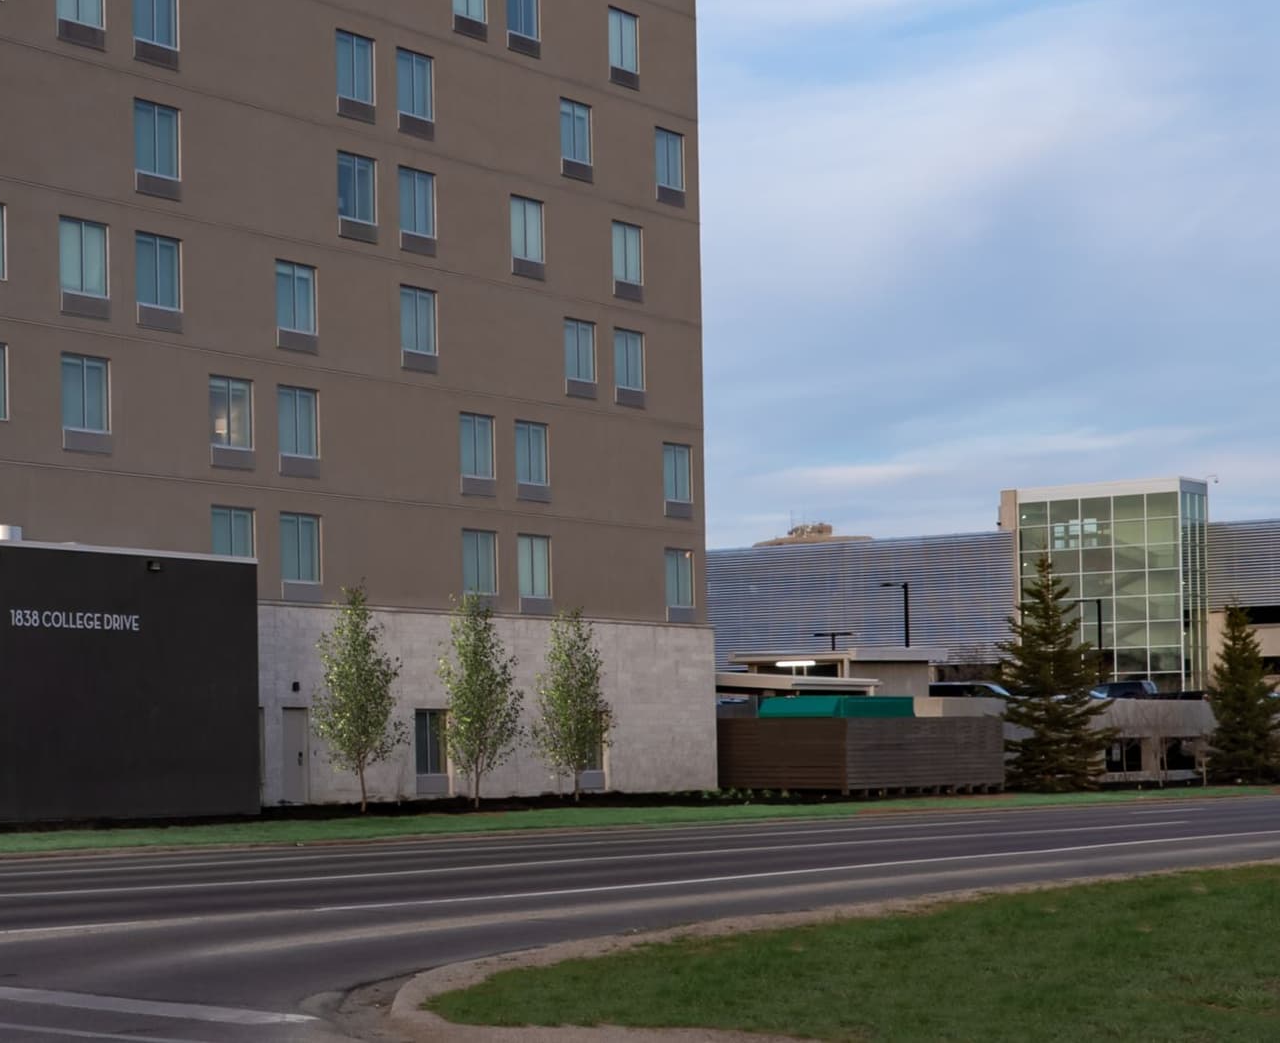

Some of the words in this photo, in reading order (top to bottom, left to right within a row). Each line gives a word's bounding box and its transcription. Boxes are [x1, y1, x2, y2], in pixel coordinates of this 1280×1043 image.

[10, 609, 40, 627] 1838
[42, 611, 102, 629] COLLEGE
[104, 614, 140, 631] DRIVE
